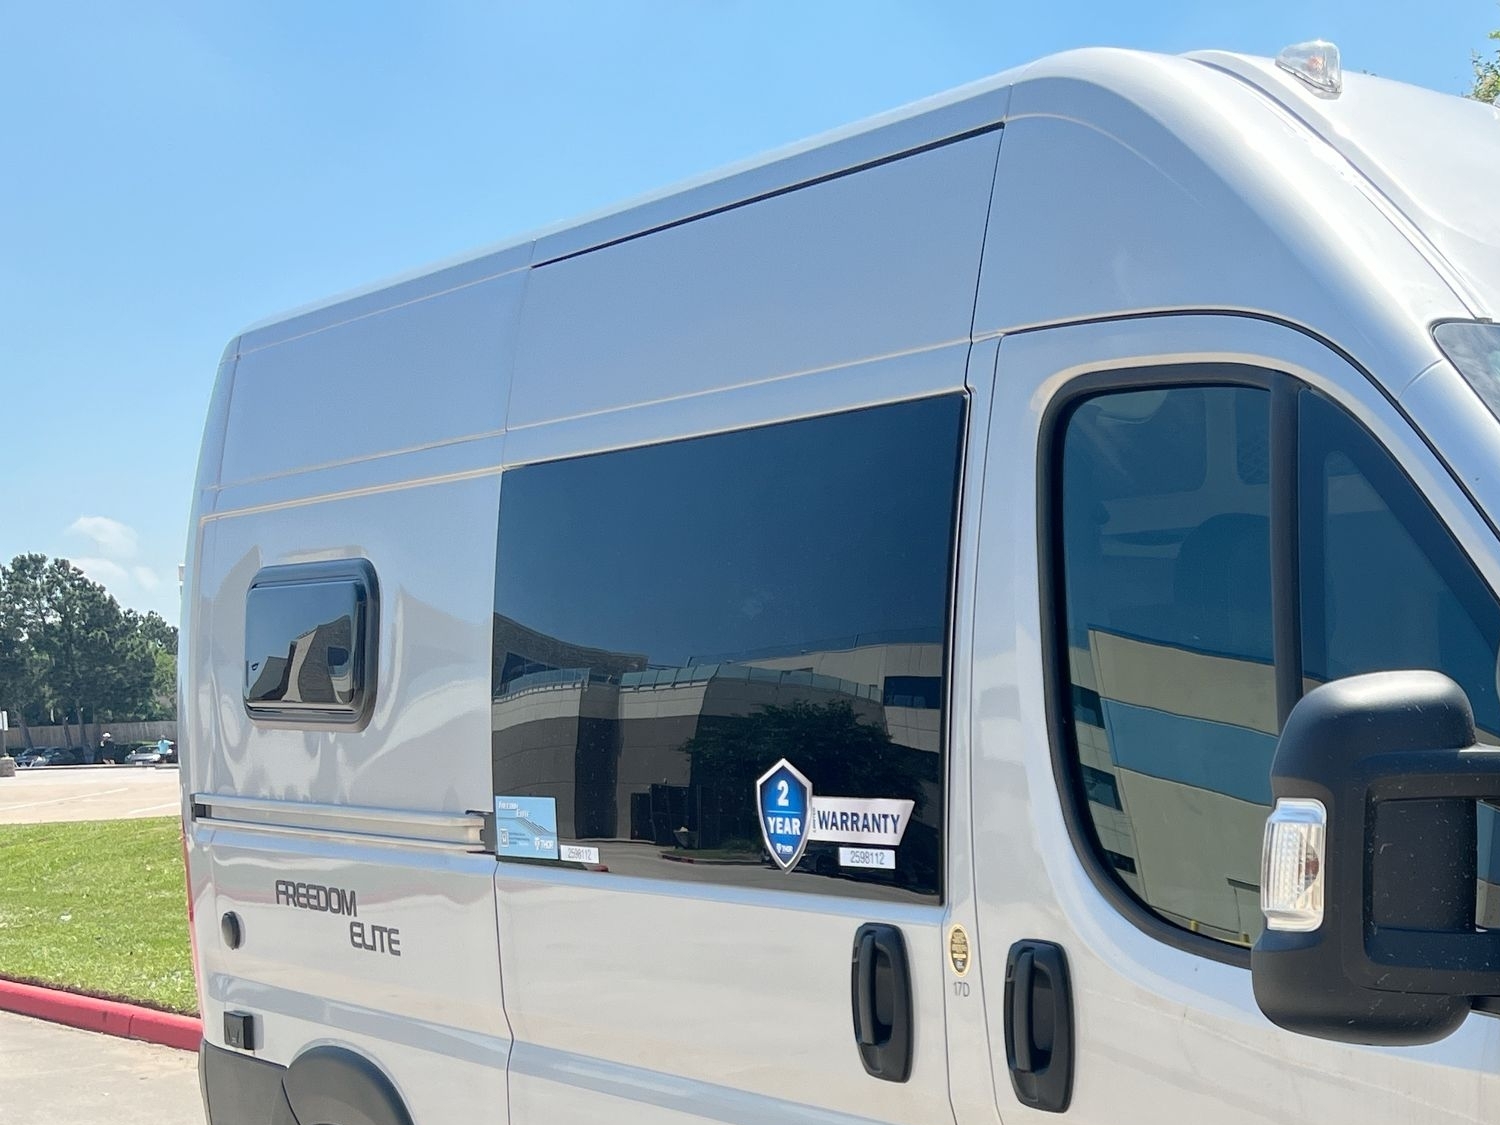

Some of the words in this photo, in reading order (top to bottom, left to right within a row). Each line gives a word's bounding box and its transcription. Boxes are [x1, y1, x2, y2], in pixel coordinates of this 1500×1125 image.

[777, 779, 790, 807] 2
[767, 816, 801, 836] YEAR
[817, 810, 900, 834] WARRANTY
[850, 850, 886, 865] 2598112
[275, 879, 357, 917] FREEDOM
[350, 921, 401, 956] ELITE
